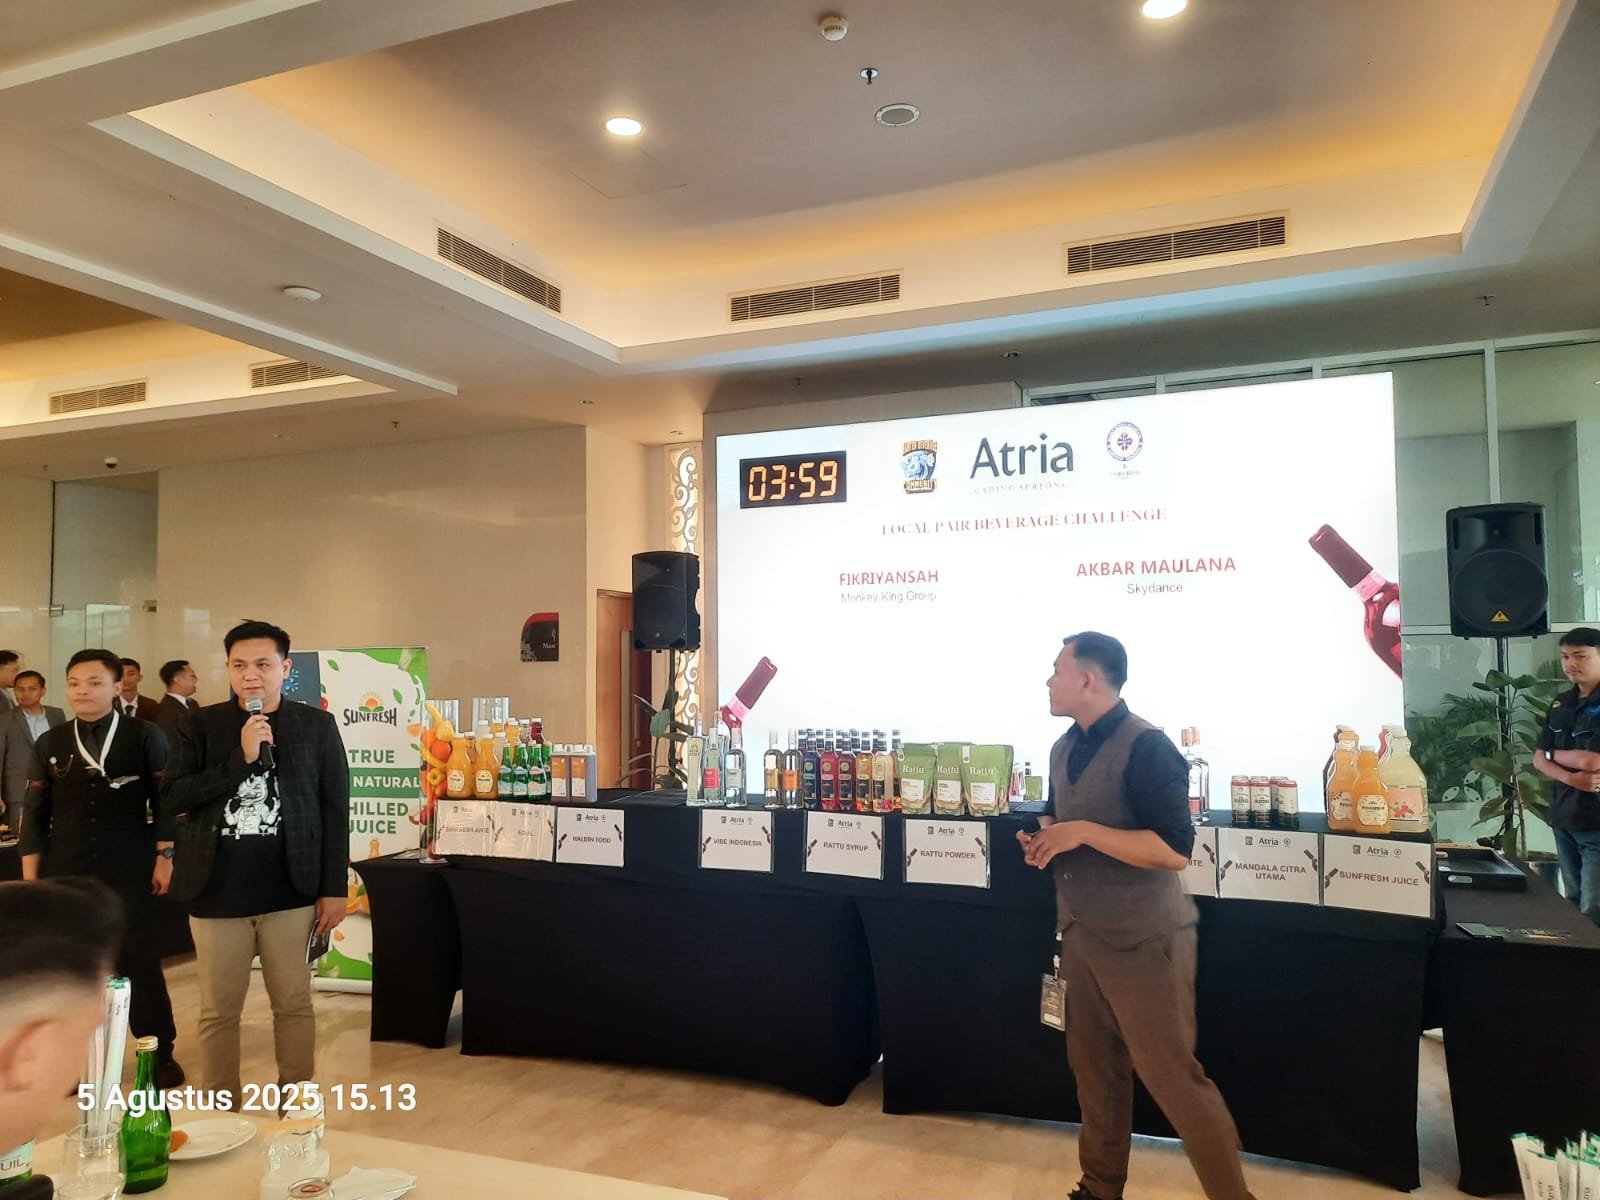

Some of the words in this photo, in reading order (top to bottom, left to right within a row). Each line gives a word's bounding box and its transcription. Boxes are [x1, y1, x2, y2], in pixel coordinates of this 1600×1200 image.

[970, 433, 1074, 479] Atria
[748, 460, 838, 501] 03:59
[882, 523, 931, 536] LOCAL
[935, 519, 972, 533] PAIR
[974, 514, 1060, 531] BEVERAGE
[1064, 508, 1167, 527] CHALLENGE
[1076, 560, 1136, 577] AKBAR
[1141, 557, 1237, 575] MAULANA
[839, 569, 939, 586] FIKRIYANSAH
[1127, 581, 1183, 595] Skydance
[841, 590, 878, 603] Monkey
[881, 590, 903, 603] King
[907, 588, 937, 602] Group
[343, 707, 397, 726] SUNFRESH
[349, 749, 395, 764] TRUE
[353, 775, 420, 789] NATURAL
[349, 802, 408, 816] HILLED
[938, 826, 955, 834] Atria
[713, 838, 728, 846] VIBE
[729, 839, 762, 848] INDONESIA
[823, 841, 846, 850] RATTU
[847, 843, 869, 852] SYRUP
[1258, 836, 1279, 846] Atria
[920, 850, 943, 859] RATTU
[945, 851, 976, 860] POWDER
[1366, 845, 1389, 857] Atria
[1235, 862, 1278, 873] MANDALA
[1280, 865, 1306, 874] CITRA
[1255, 872, 1286, 882] UTAMA
[1339, 869, 1389, 884] SUNFRESH
[1392, 875, 1419, 886] JUICE
